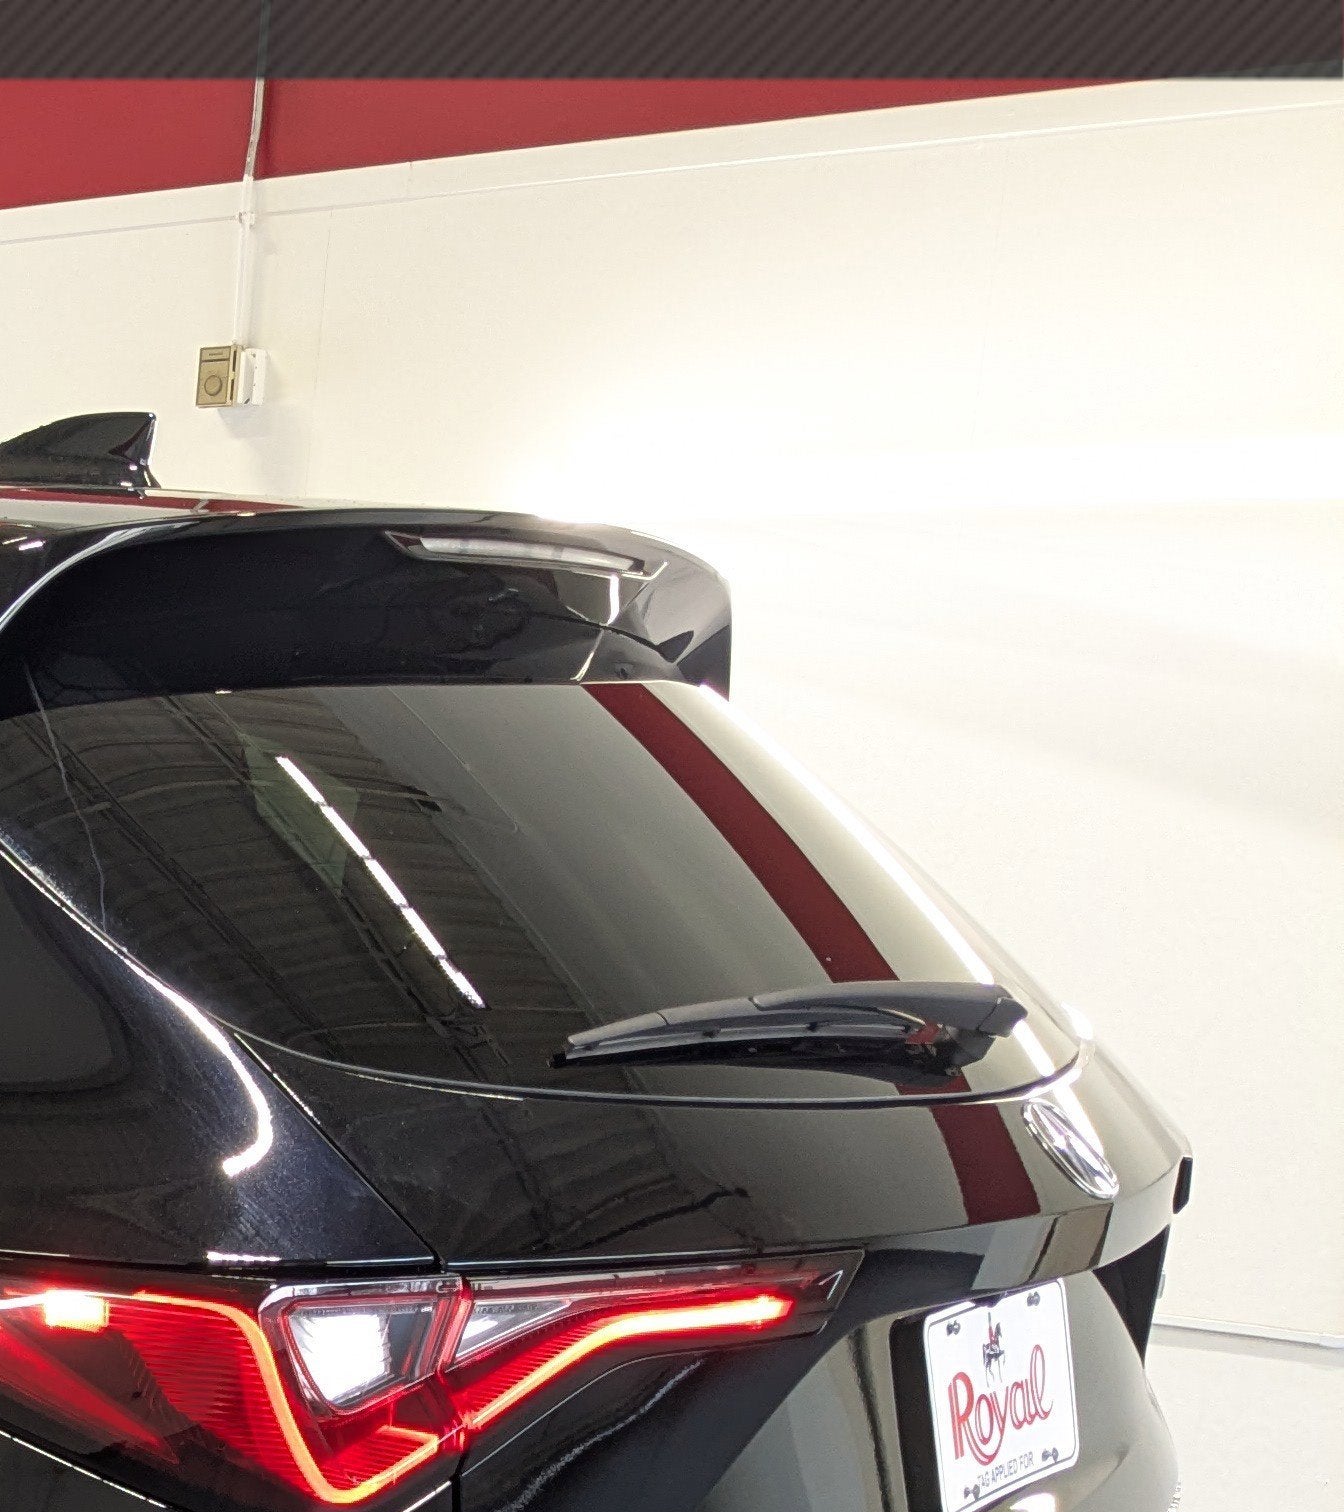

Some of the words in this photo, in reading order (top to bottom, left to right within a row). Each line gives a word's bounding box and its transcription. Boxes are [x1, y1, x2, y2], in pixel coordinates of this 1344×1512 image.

[948, 1344, 1054, 1466] Royal
[977, 1471, 991, 1488] TAG
[991, 1457, 1018, 1483] APPLIED
[1018, 1451, 1034, 1470] FOR
